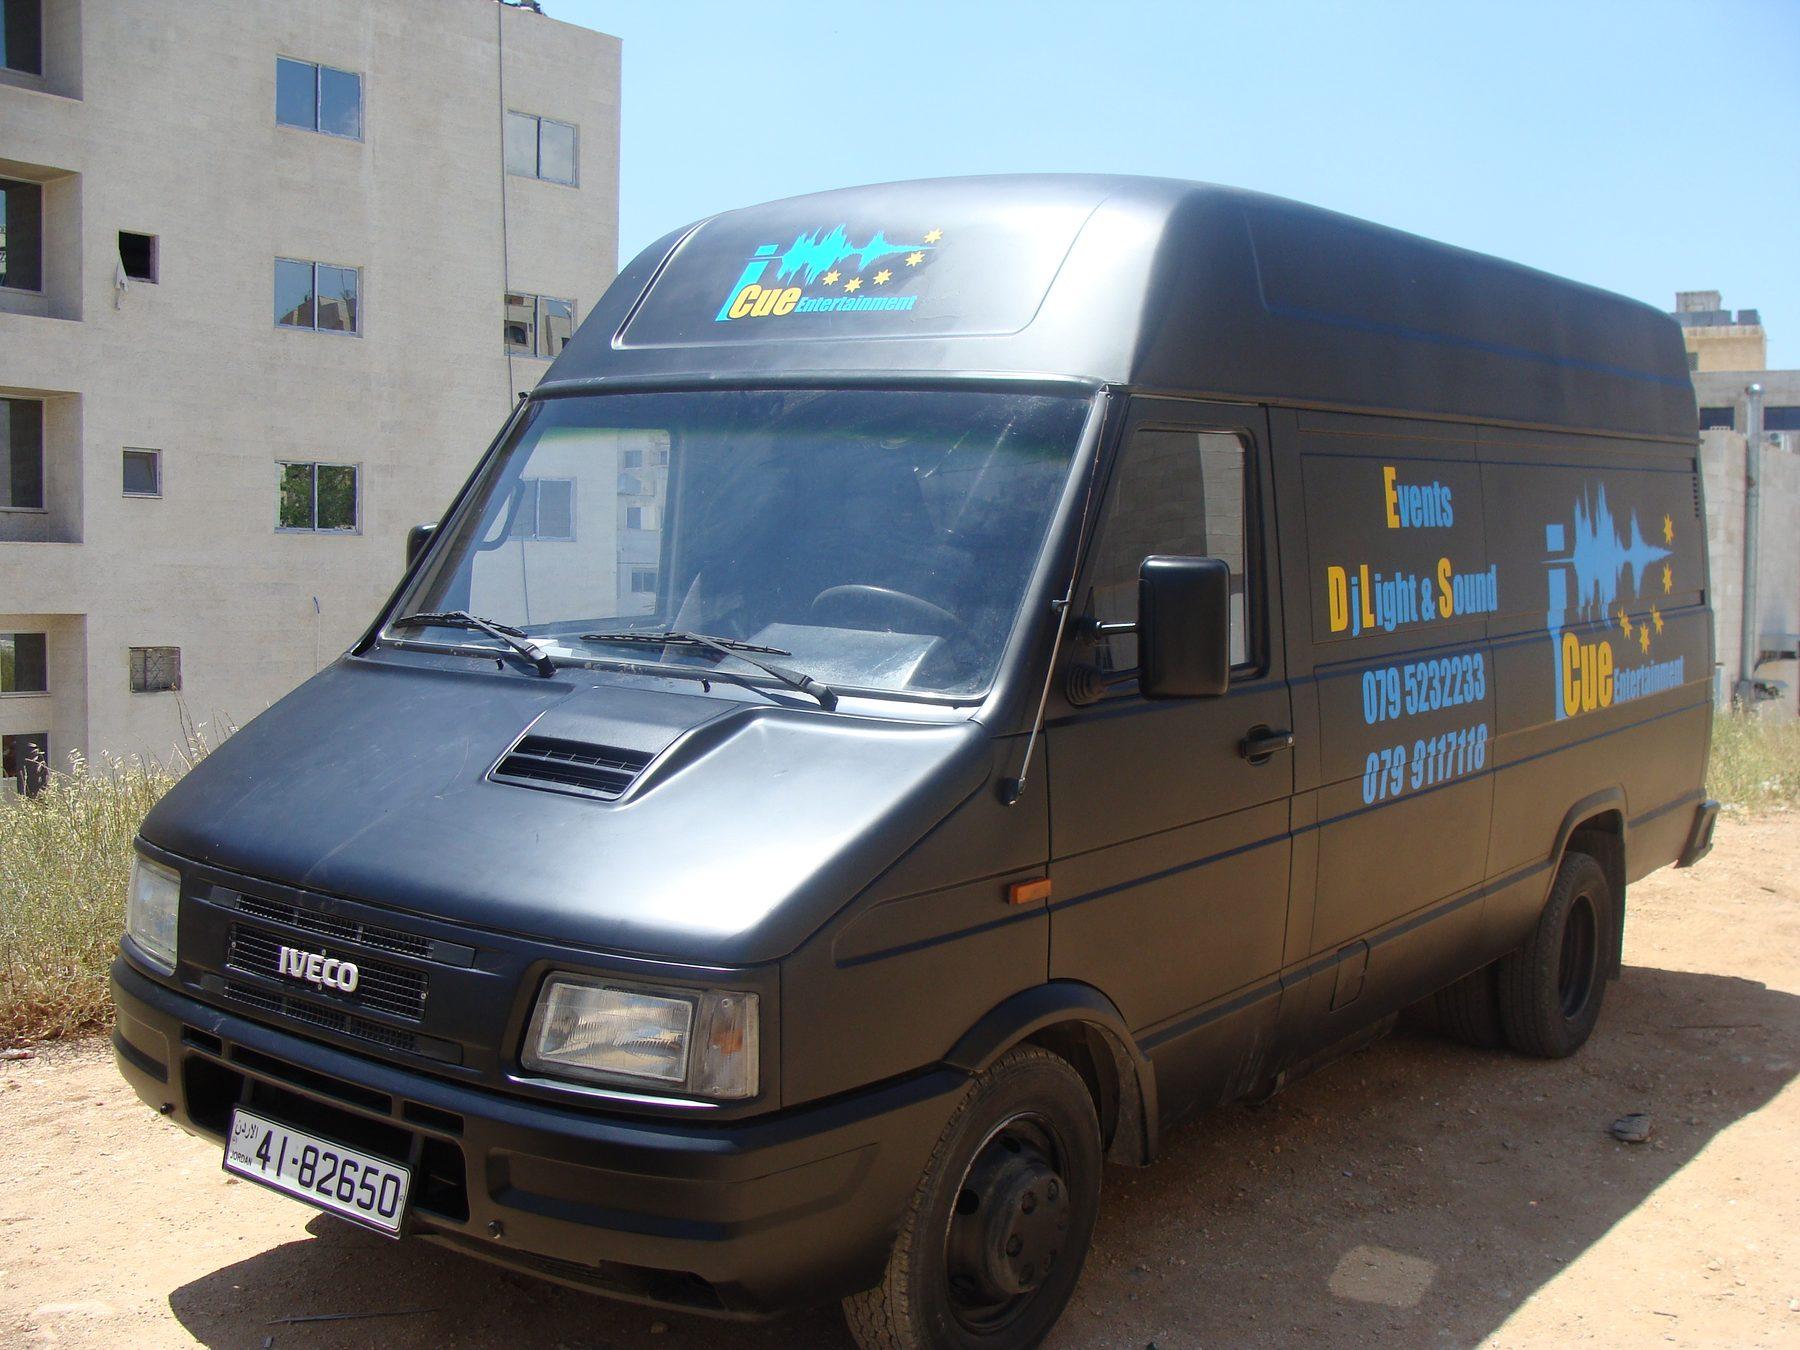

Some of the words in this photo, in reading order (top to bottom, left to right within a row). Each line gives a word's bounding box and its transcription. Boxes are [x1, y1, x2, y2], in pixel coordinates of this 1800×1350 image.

[794, 295, 918, 313] Entertainment
[1383, 466, 1454, 528] Events
[1421, 577, 1436, 622] &
[1437, 557, 1498, 619] Sound
[1362, 666, 1400, 725] 079
[1404, 652, 1486, 716] 5232233
[1613, 655, 1684, 704] Entertainment
[1362, 744, 1406, 805] 079
[1410, 723, 1488, 790] 9117118
[279, 945, 359, 993] IVECO
[230, 1150, 252, 1166] JORDAN
[255, 1129, 401, 1219] 41-82650
